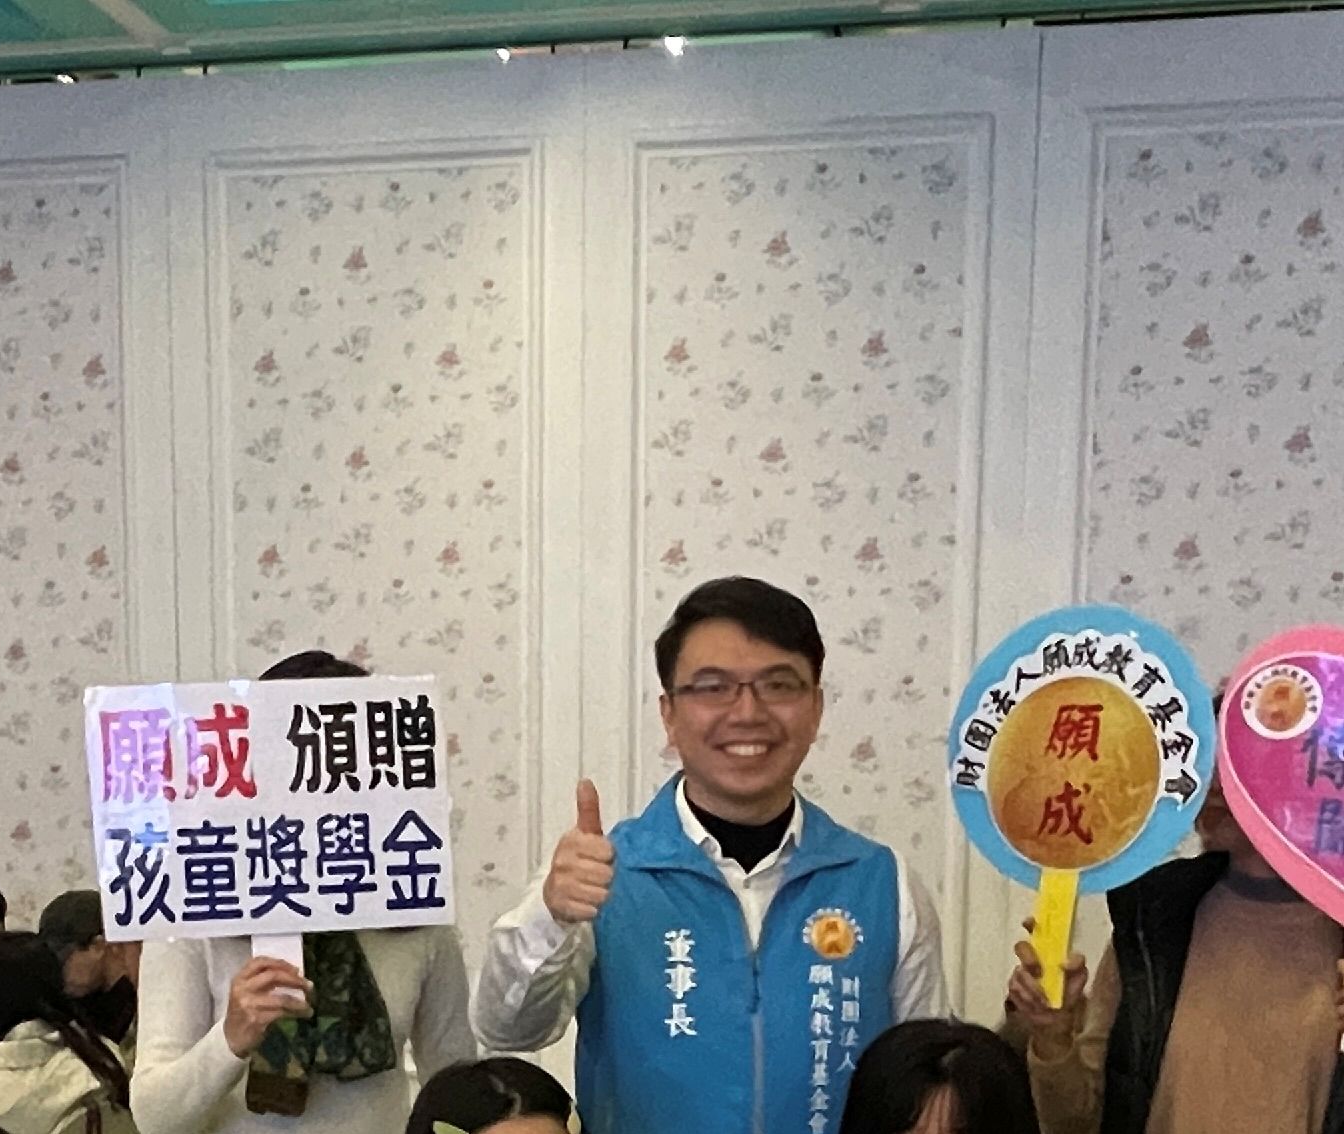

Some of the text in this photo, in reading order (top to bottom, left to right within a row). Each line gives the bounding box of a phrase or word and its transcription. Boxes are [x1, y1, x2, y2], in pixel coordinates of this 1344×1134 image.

[99, 695, 437, 803] 願成 頒贈
[1038, 704, 1104, 845] 願成
[104, 809, 446, 927] 孩童獎學金
[663, 929, 698, 1038] 董事長
